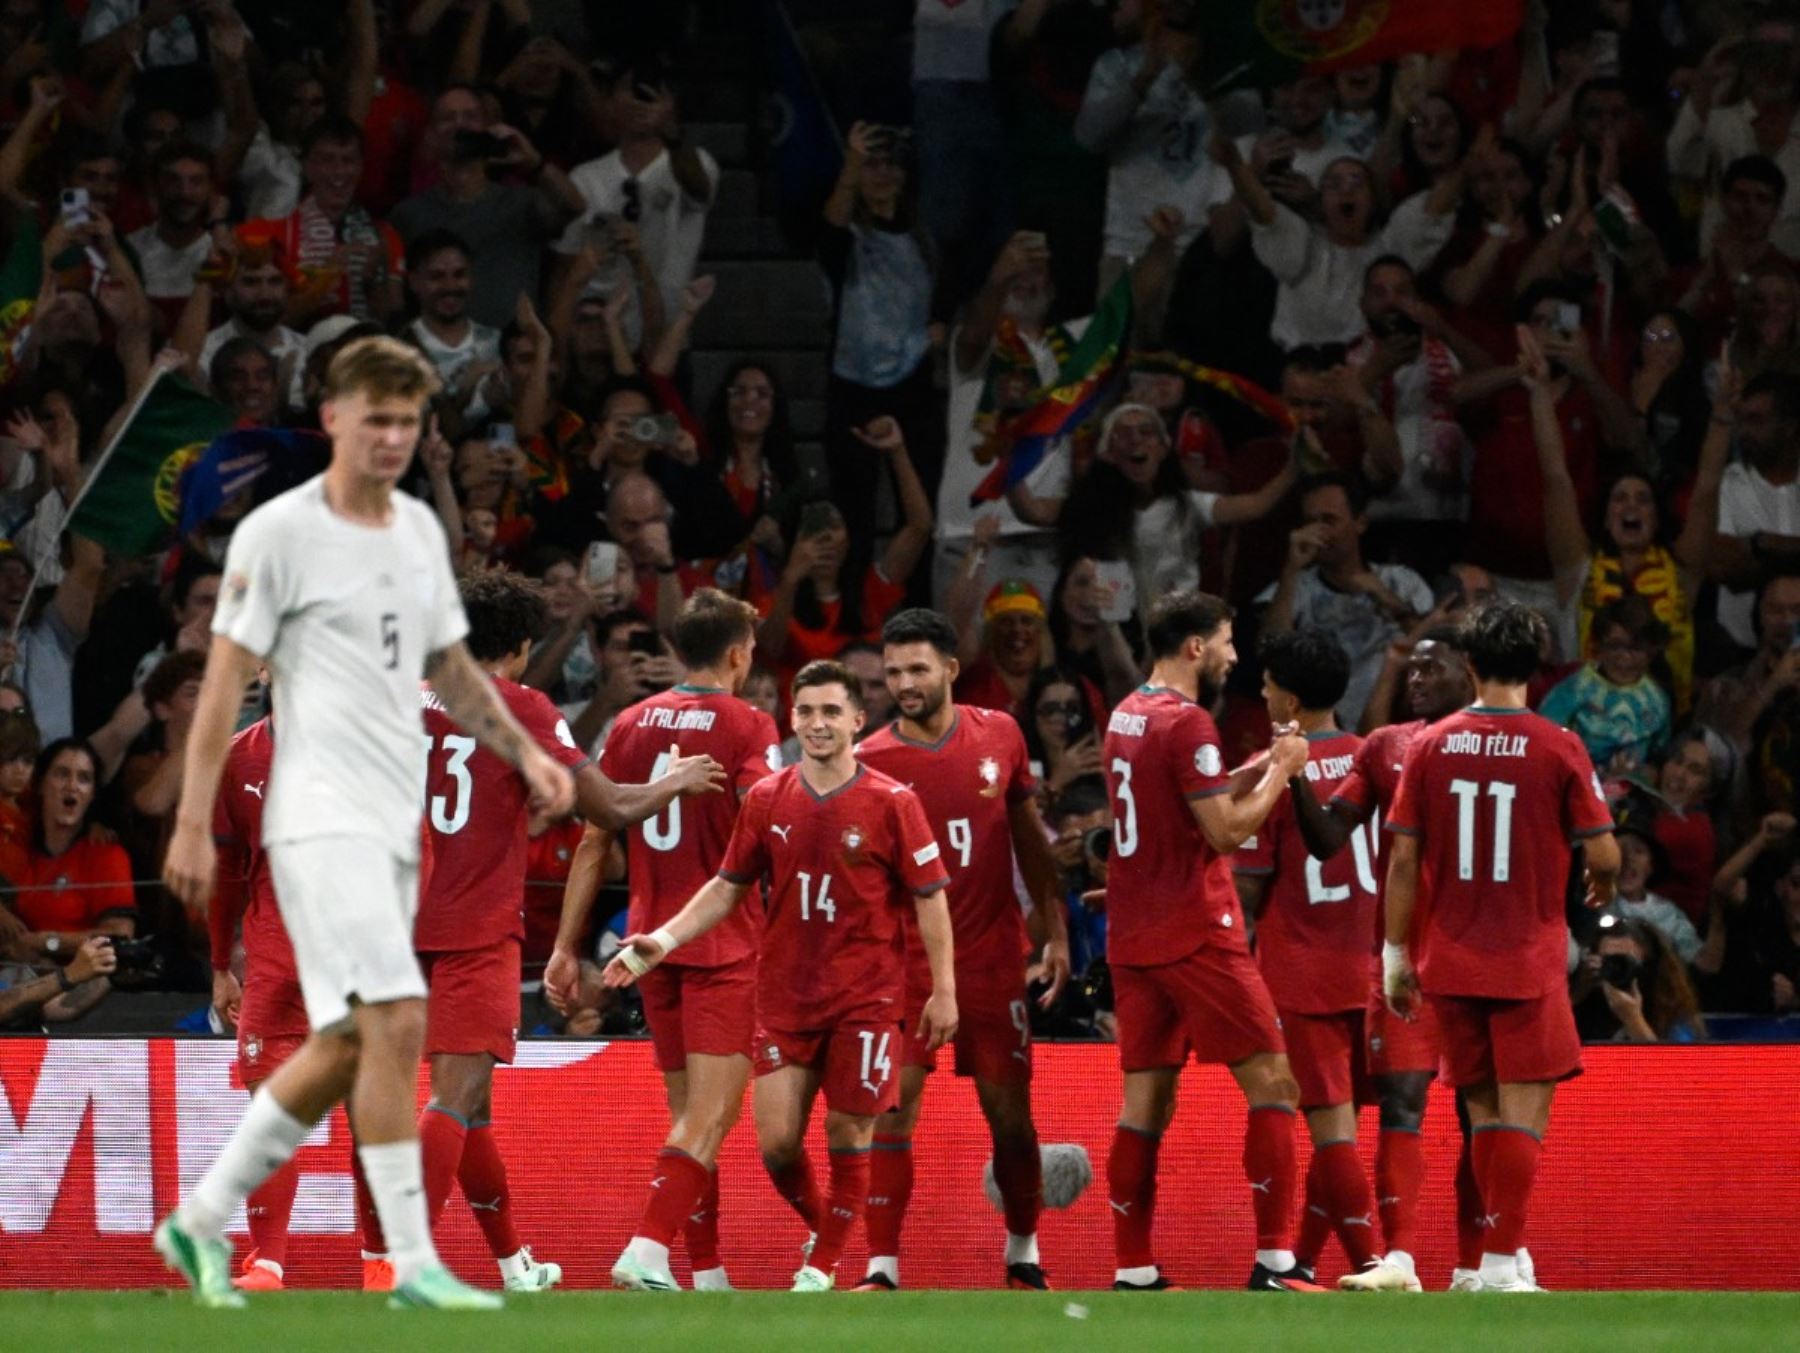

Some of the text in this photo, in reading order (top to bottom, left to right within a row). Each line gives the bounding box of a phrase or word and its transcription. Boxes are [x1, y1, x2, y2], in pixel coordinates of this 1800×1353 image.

[381, 613, 400, 671] 5
[1441, 730, 1529, 757] JOÃO FÉLIX
[1112, 757, 1138, 857] 3
[1449, 779, 1517, 882] 11
[947, 818, 972, 867] 9
[797, 871, 836, 922] 14
[1010, 1000, 1028, 1047] 9
[858, 1031, 891, 1081] 14
